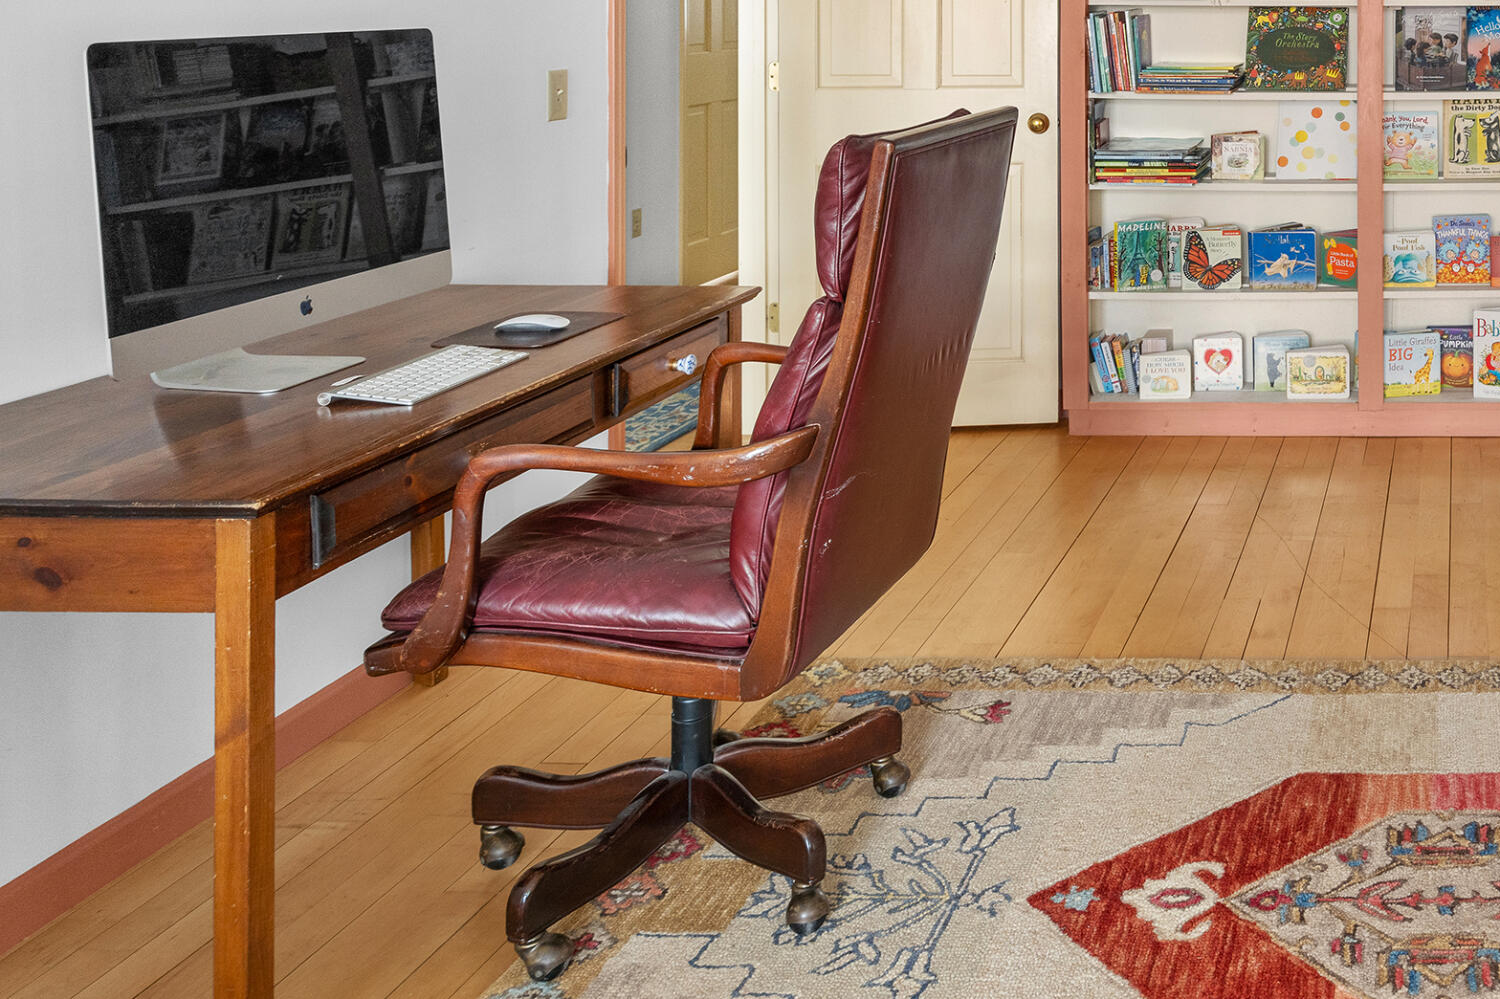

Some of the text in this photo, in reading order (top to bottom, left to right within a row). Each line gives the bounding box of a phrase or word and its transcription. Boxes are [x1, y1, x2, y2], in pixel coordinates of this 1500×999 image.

[1295, 32, 1317, 42] Story
[1275, 38, 1320, 49] Orchestra
[1391, 123, 1426, 132] Everything
[1118, 221, 1167, 232] MADELINE
[1437, 228, 1489, 239] THANKFUL THINGS
[1208, 240, 1237, 249] Butterfly
[1329, 256, 1355, 268] Pasta
[1388, 336, 1437, 347] Little Giraffe's
[1388, 347, 1413, 361] BIG
[1388, 363, 1404, 372] Idea
